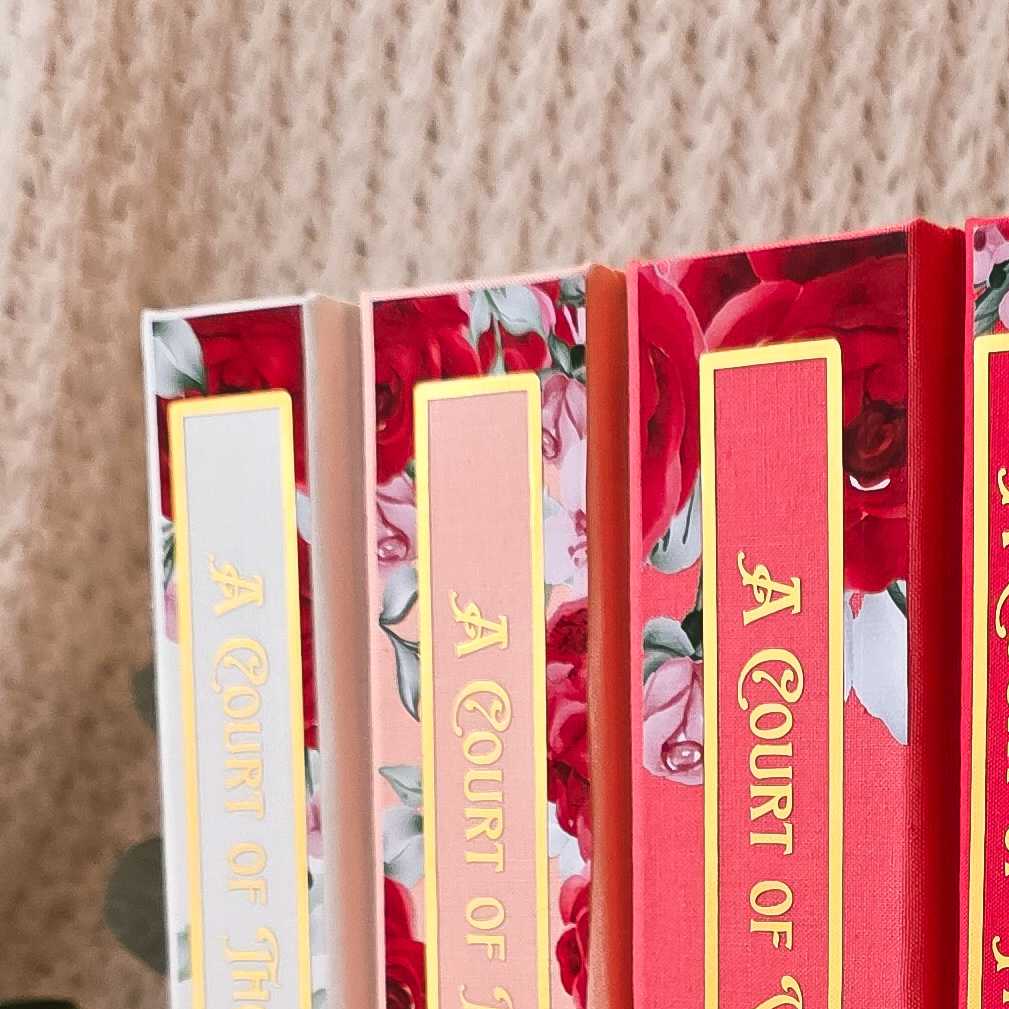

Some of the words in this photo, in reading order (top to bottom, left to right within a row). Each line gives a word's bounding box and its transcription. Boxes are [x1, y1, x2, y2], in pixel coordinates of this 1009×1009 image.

[207, 553, 264, 617] A
[737, 551, 801, 625] A
[450, 591, 509, 659] A
[211, 635, 270, 820] COURT
[737, 647, 804, 856] COURT
[453, 679, 512, 872] COURT
[227, 842, 268, 905] OF
[464, 897, 505, 961] OF
[749, 880, 793, 950] OF
